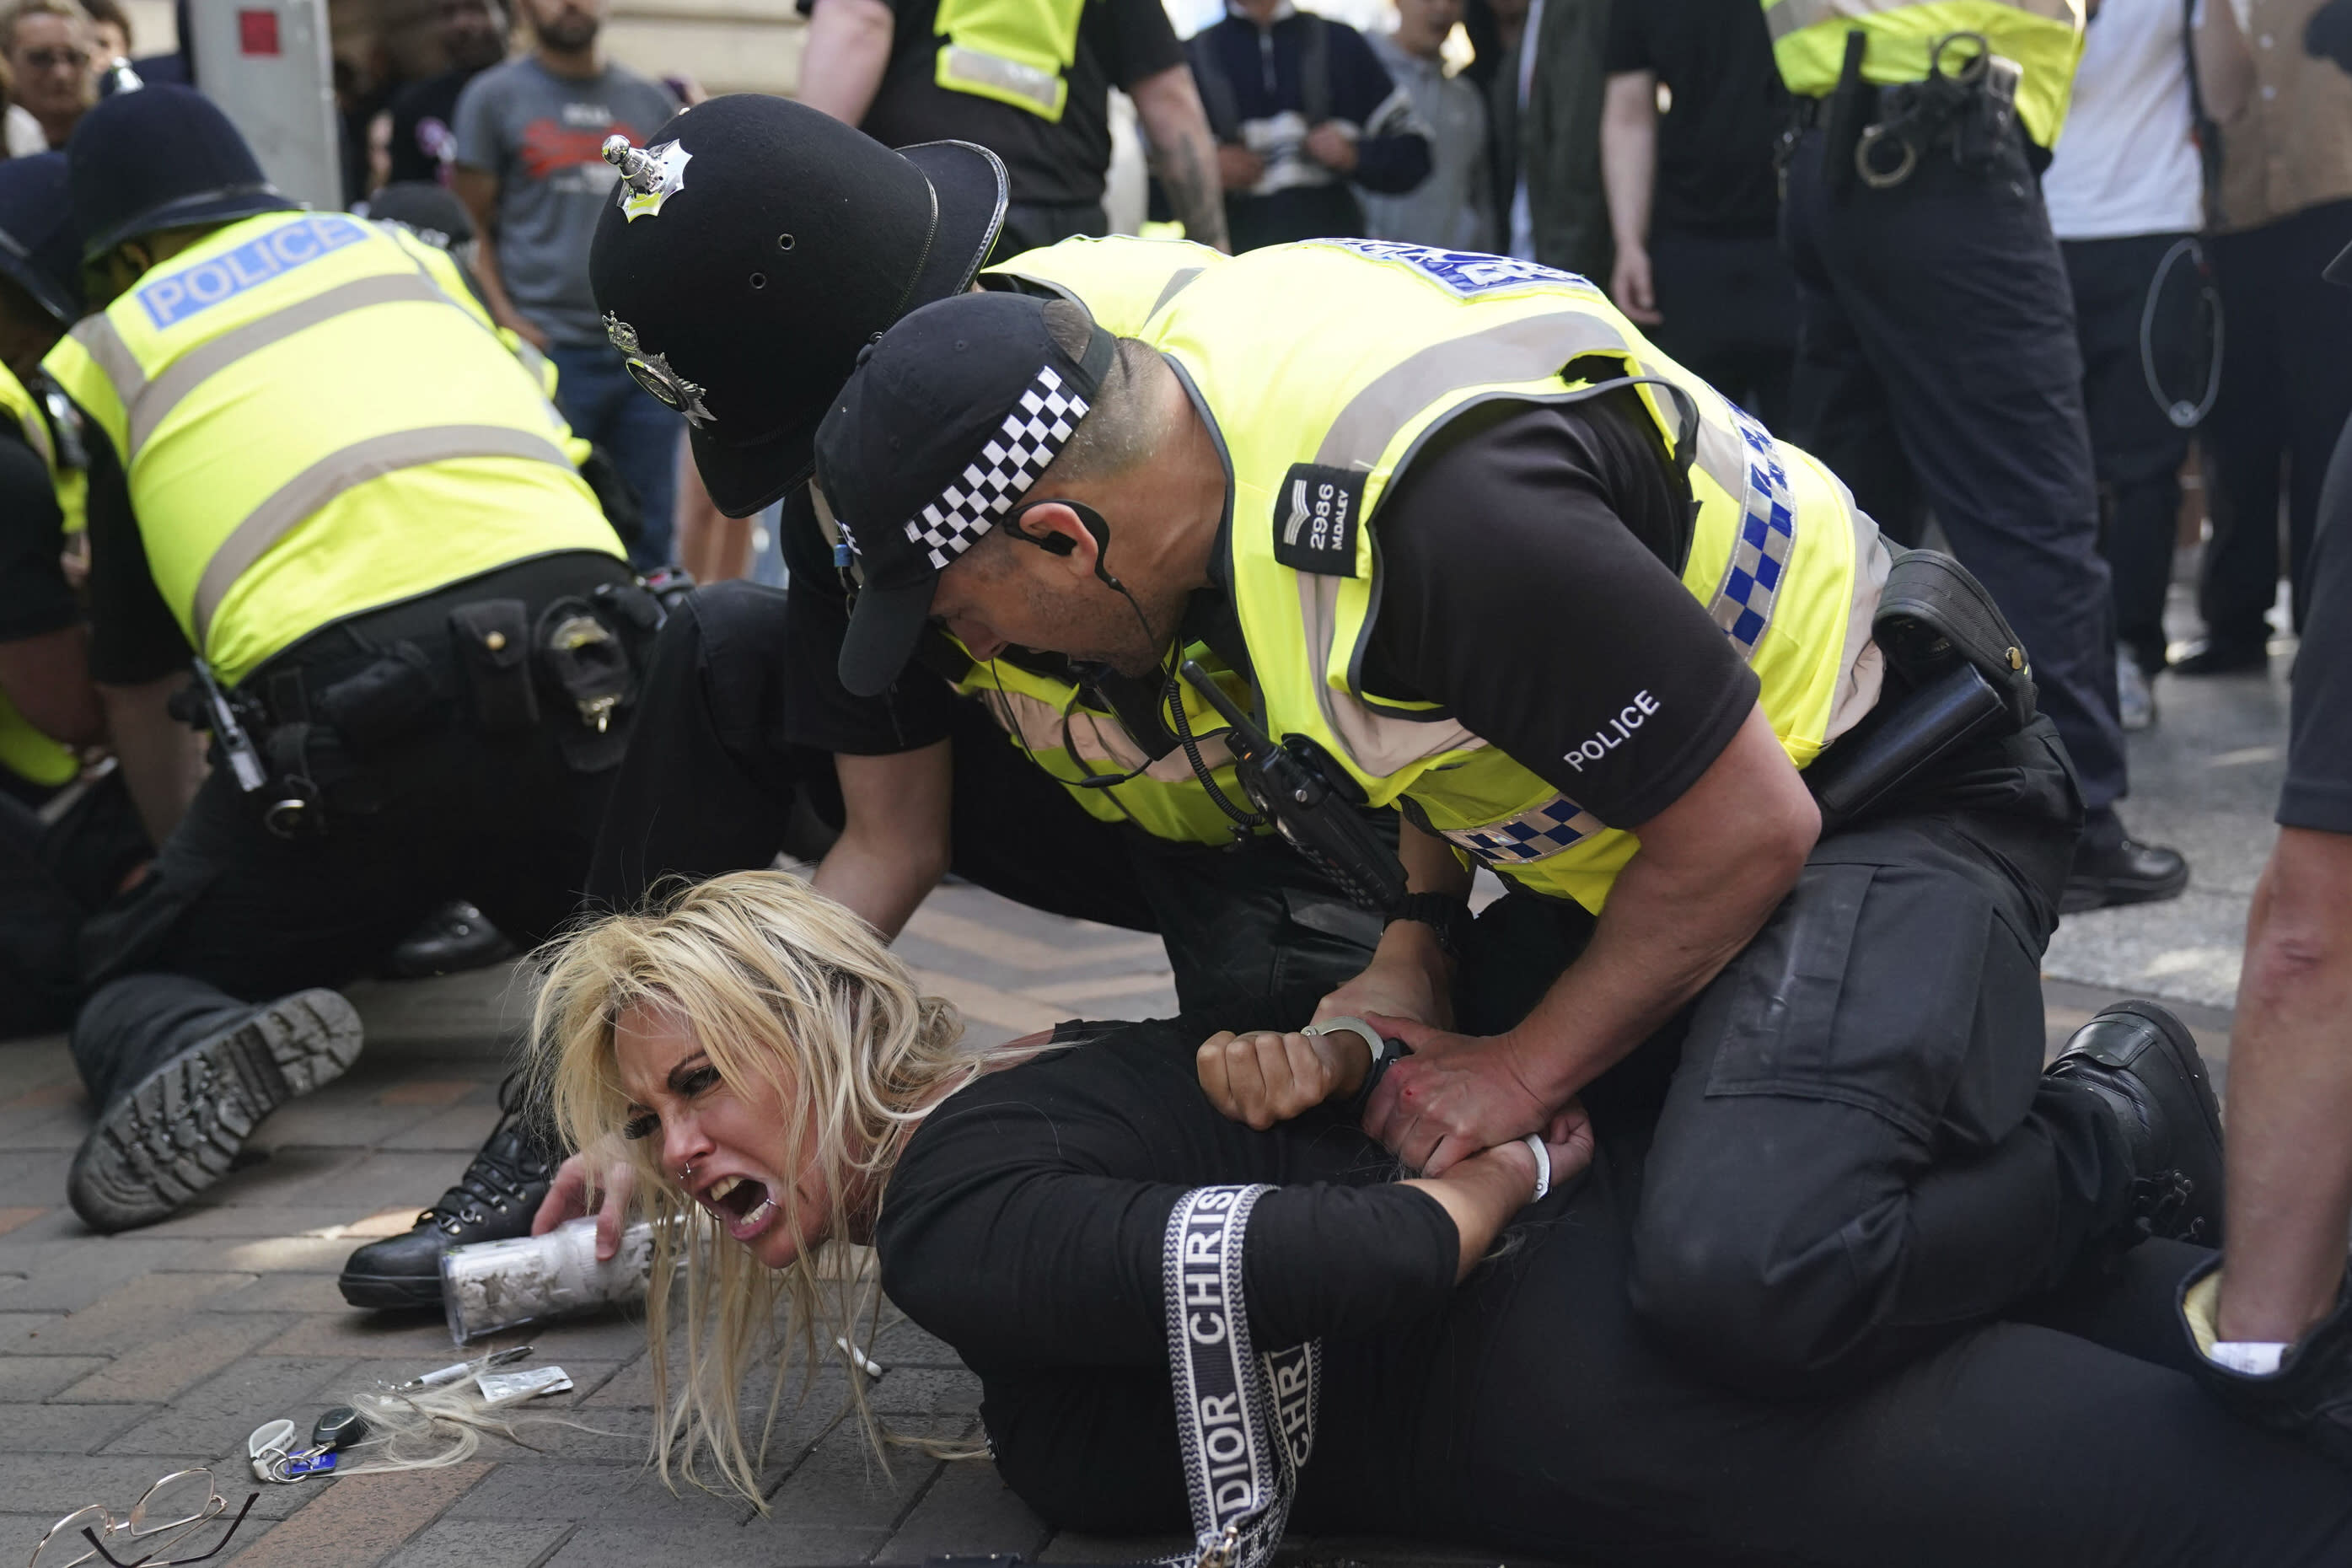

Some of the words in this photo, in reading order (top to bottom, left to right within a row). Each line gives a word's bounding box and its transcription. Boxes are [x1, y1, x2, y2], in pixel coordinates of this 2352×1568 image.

[146, 217, 357, 323] POLICE
[1310, 483, 1334, 550] 2986
[1563, 690, 1661, 772] POLICE
[1200, 1392, 1253, 1515] DIOR
